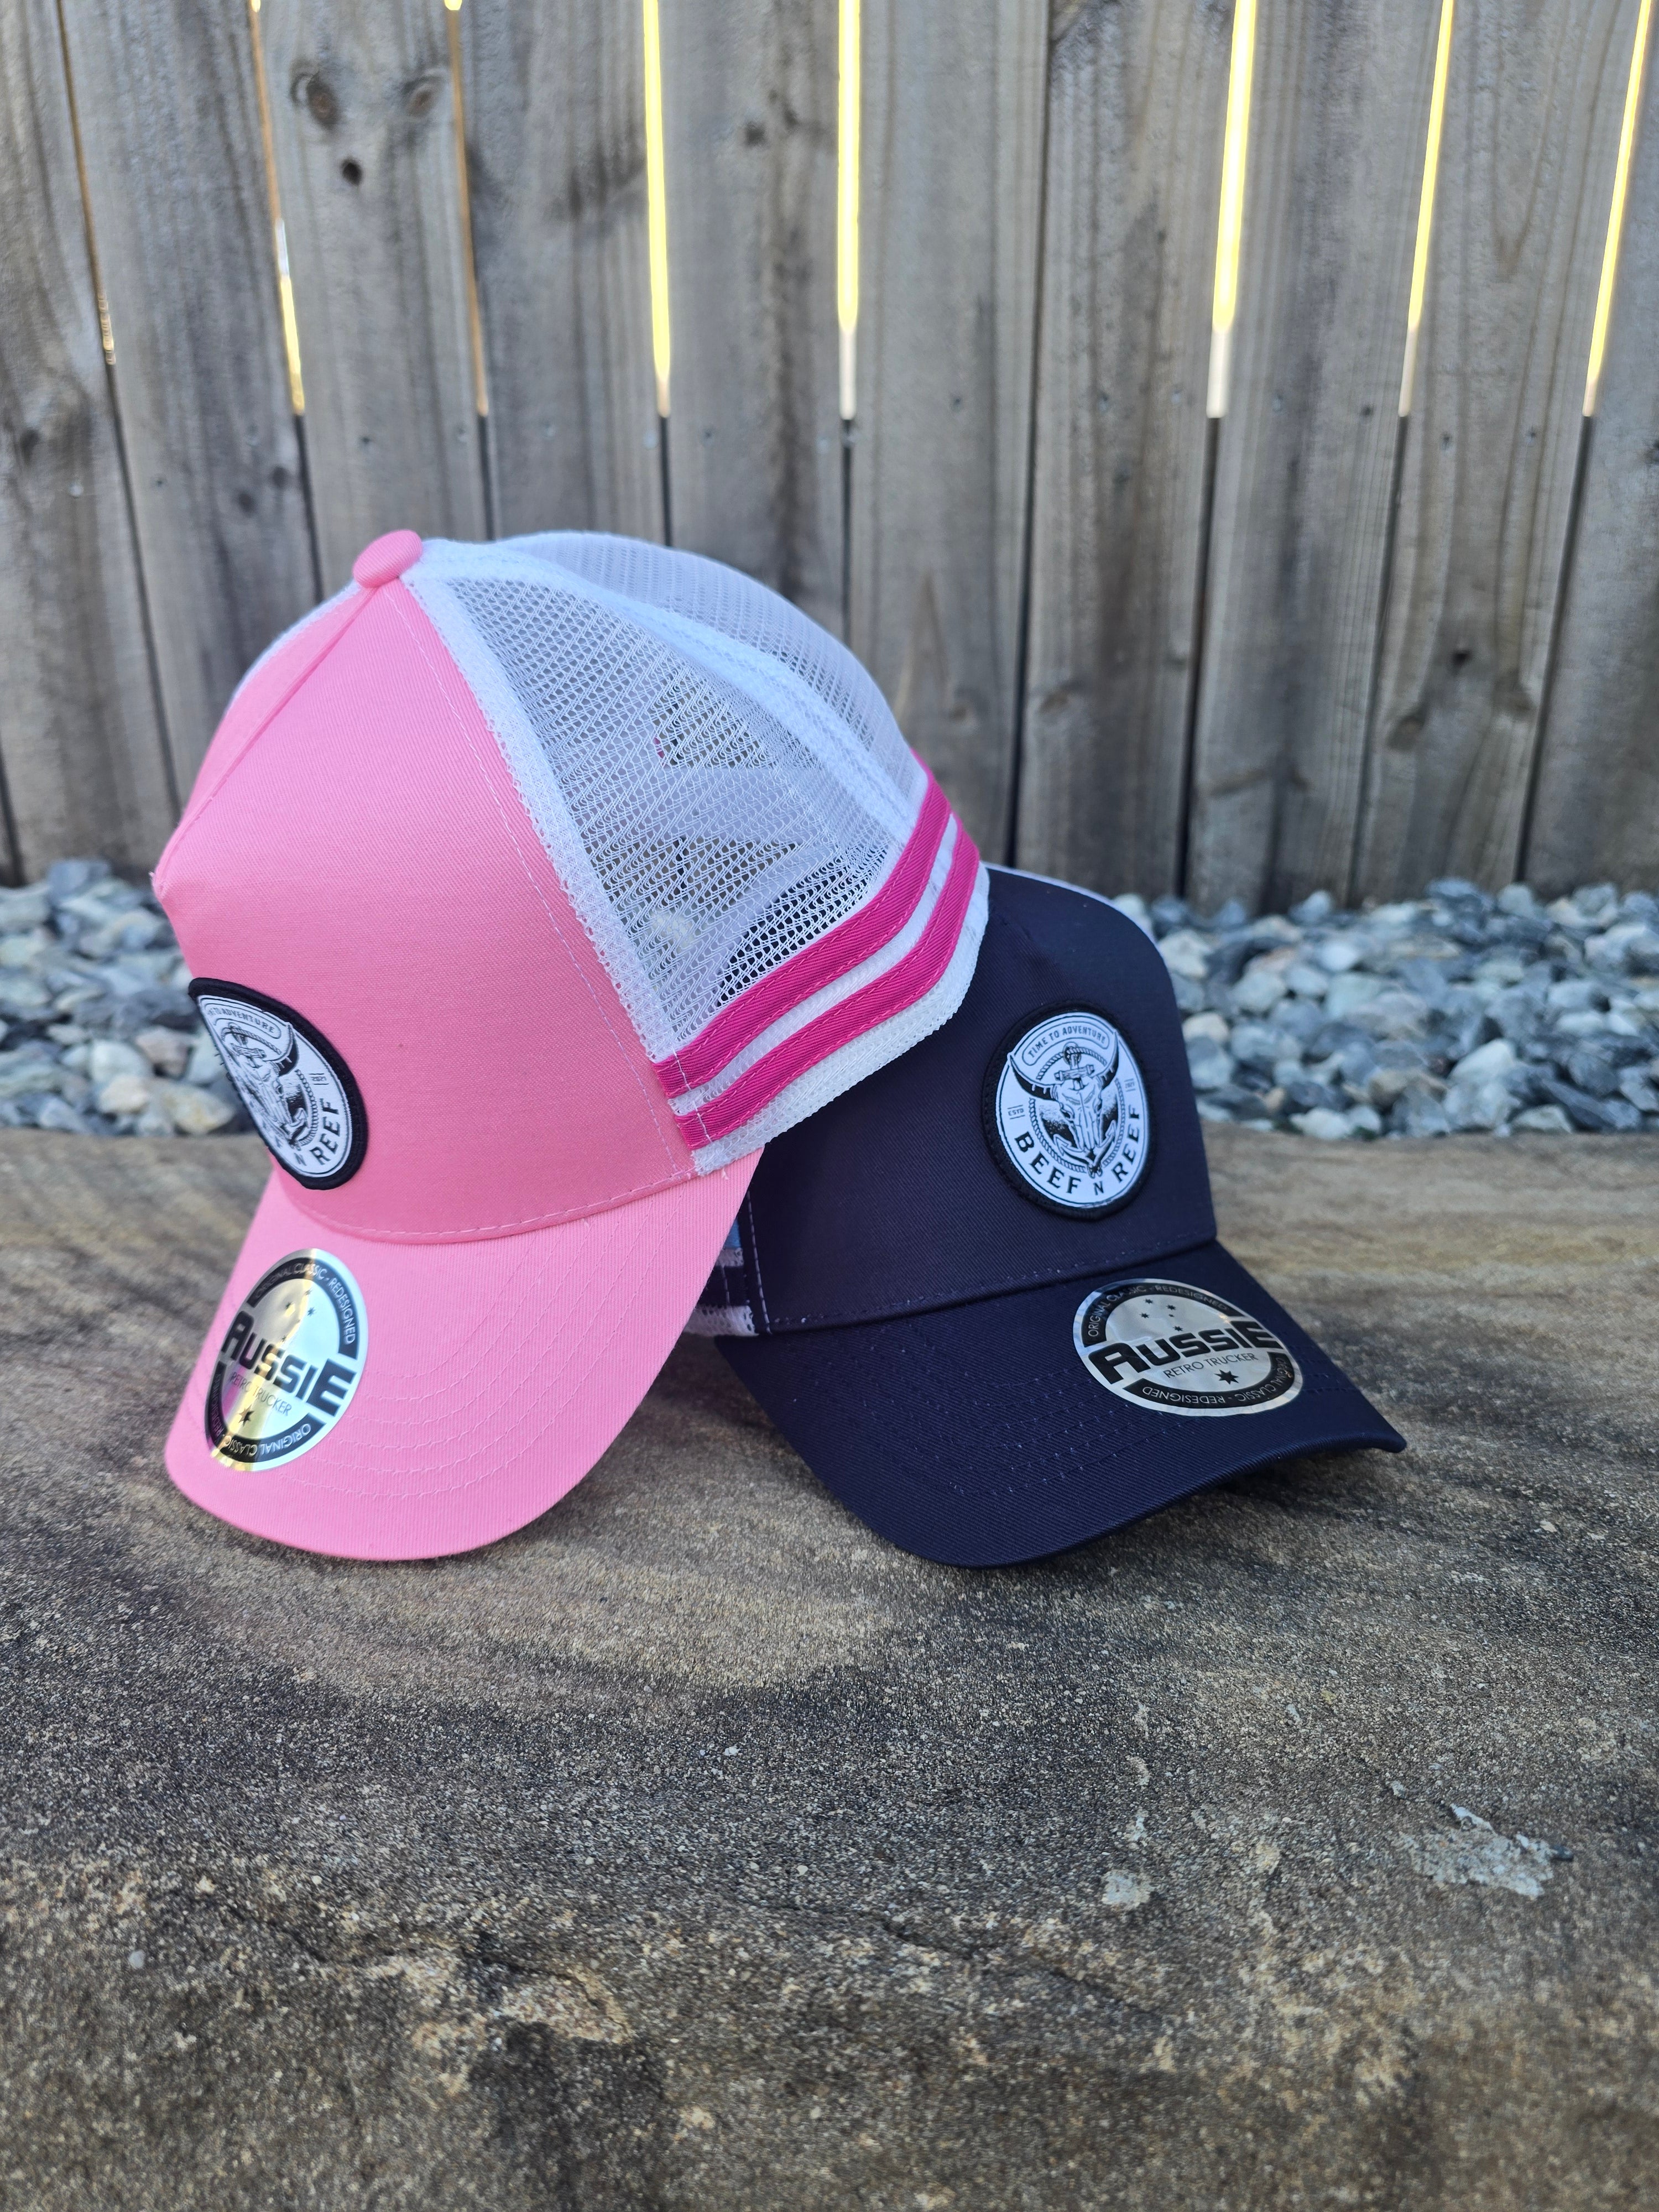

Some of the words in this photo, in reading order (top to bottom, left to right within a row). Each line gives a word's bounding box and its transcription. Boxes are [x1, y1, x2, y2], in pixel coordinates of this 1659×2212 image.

[222, 1008, 275, 1034] ADVENTURE
[1027, 1037, 1048, 1058] TIME
[1048, 1030, 1060, 1041] TO
[1062, 1026, 1106, 1044] ADVENTURE
[1008, 1108, 1024, 1116] ESTD
[310, 1098, 341, 1165] REEF
[1014, 1132, 1081, 1194] BEEF
[1093, 1181, 1104, 1196] N
[1112, 1104, 1140, 1183] REEF
[327, 1277, 356, 1344] REDESIGNED
[1088, 1301, 1110, 1337] ORIGINAL
[1155, 1285, 1228, 1310] REDESIGNED
[222, 1310, 357, 1417] AUSSIE
[1088, 1321, 1284, 1384] AUSSIE
[1164, 1361, 1204, 1379] RETRO
[1206, 1353, 1258, 1368] TRUCKER
[229, 1371, 252, 1392] RETRO
[252, 1385, 292, 1416] TRUCKER
[1142, 1386, 1225, 1404] REDESIGNED
[1234, 1384, 1276, 1401] CLASSIC
[225, 1435, 258, 1456] CLASSIC
[259, 1423, 312, 1454] ORIGINAL
